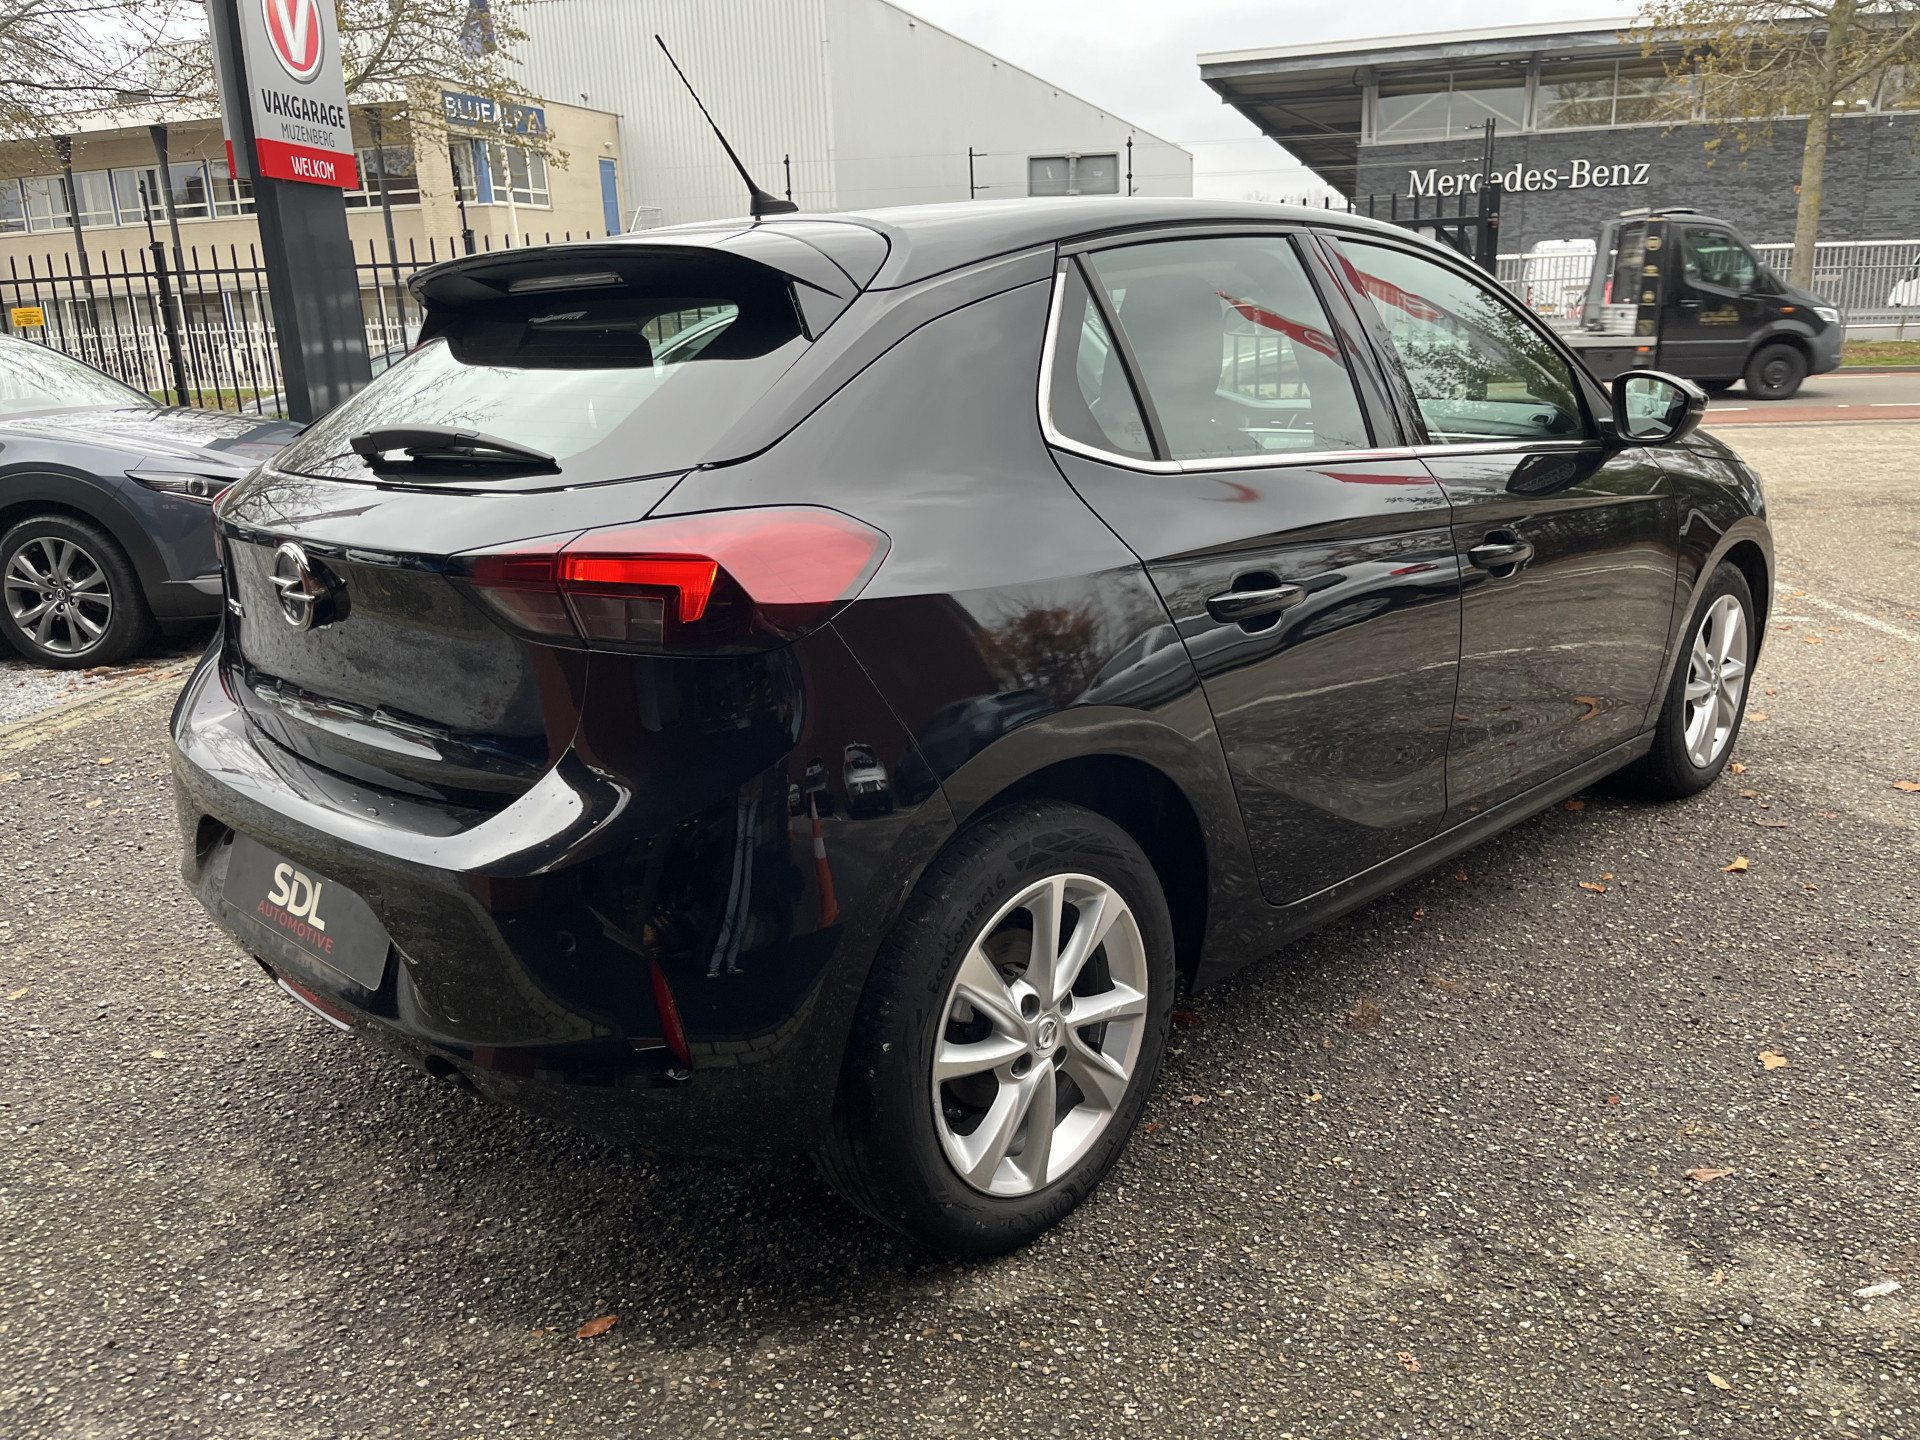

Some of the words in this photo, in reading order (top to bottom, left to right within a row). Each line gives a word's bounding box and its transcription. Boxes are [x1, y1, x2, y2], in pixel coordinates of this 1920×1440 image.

[261, 88, 345, 129] VAKGARAGE
[281, 122, 335, 148] MUZENBERG
[291, 155, 336, 181] WELKOM
[1407, 159, 1650, 198] Mercedes-Benz
[267, 862, 325, 932] SDL
[257, 899, 335, 955] AUTOMOTIVE
[926, 885, 996, 994] EcoContact
[996, 872, 1006, 890] 6
